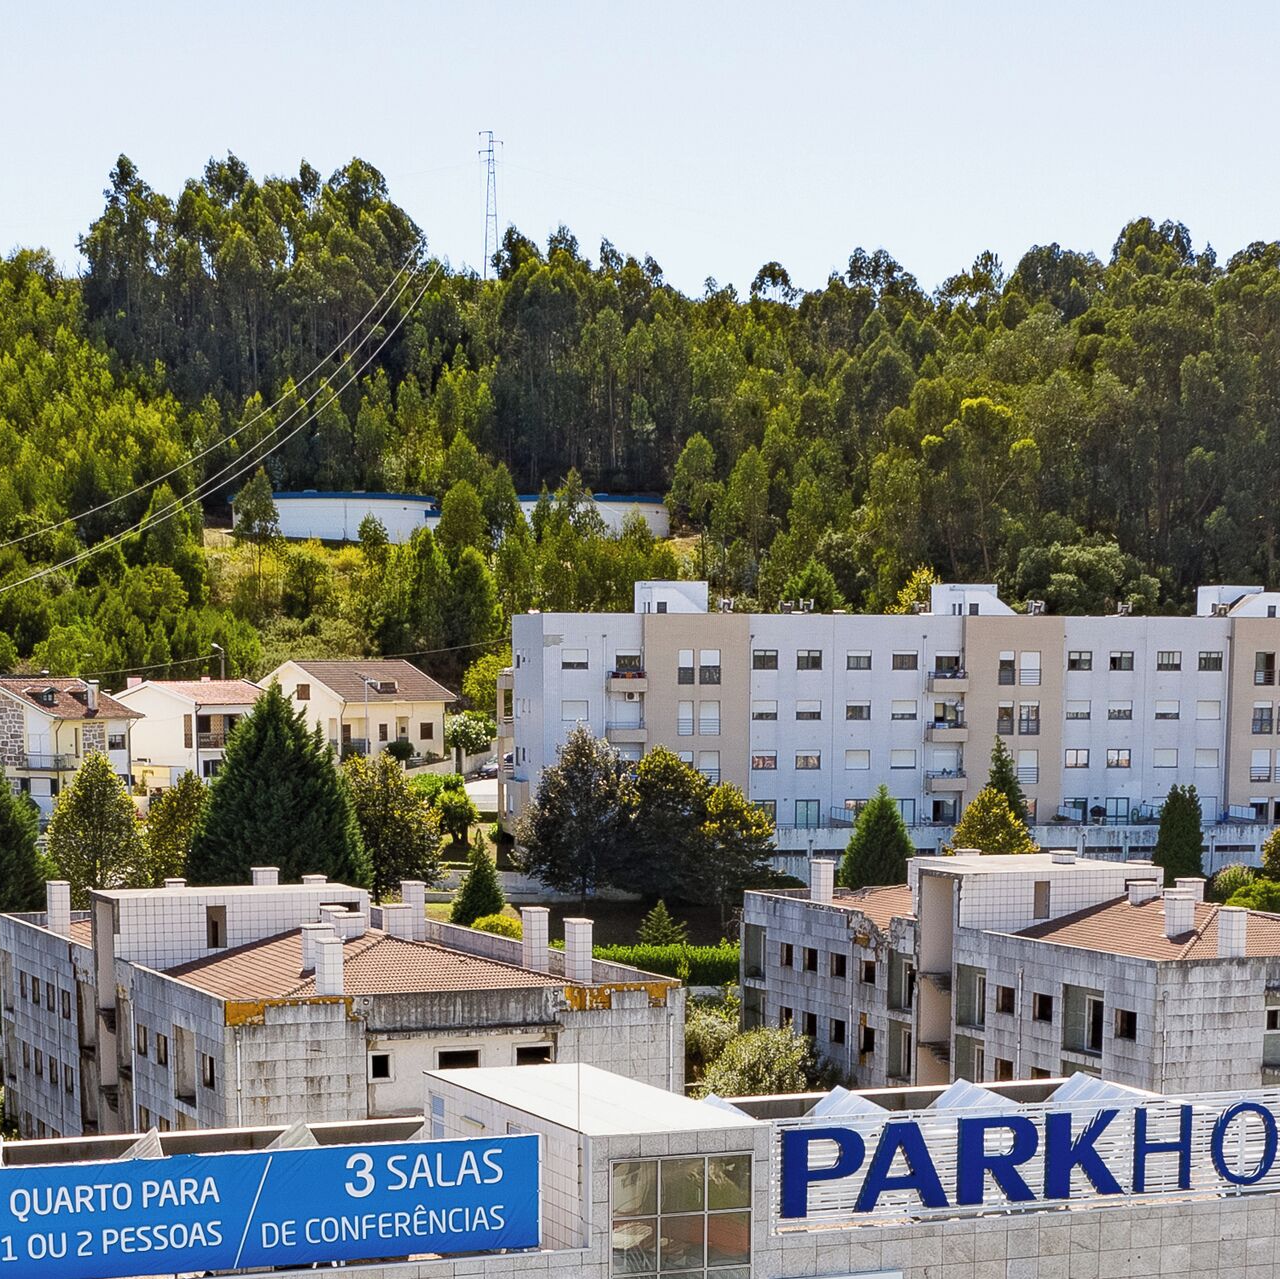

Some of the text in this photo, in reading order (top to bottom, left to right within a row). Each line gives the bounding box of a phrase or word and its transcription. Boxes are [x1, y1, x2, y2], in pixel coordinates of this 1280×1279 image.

[344, 1148, 503, 1198] 3 SALAS
[9, 1176, 220, 1223] QUARTO PARA
[1, 1220, 223, 1261] 1 OU 2 PESSOAS
[261, 1203, 505, 1248] DE CONFERÊNCIAS
